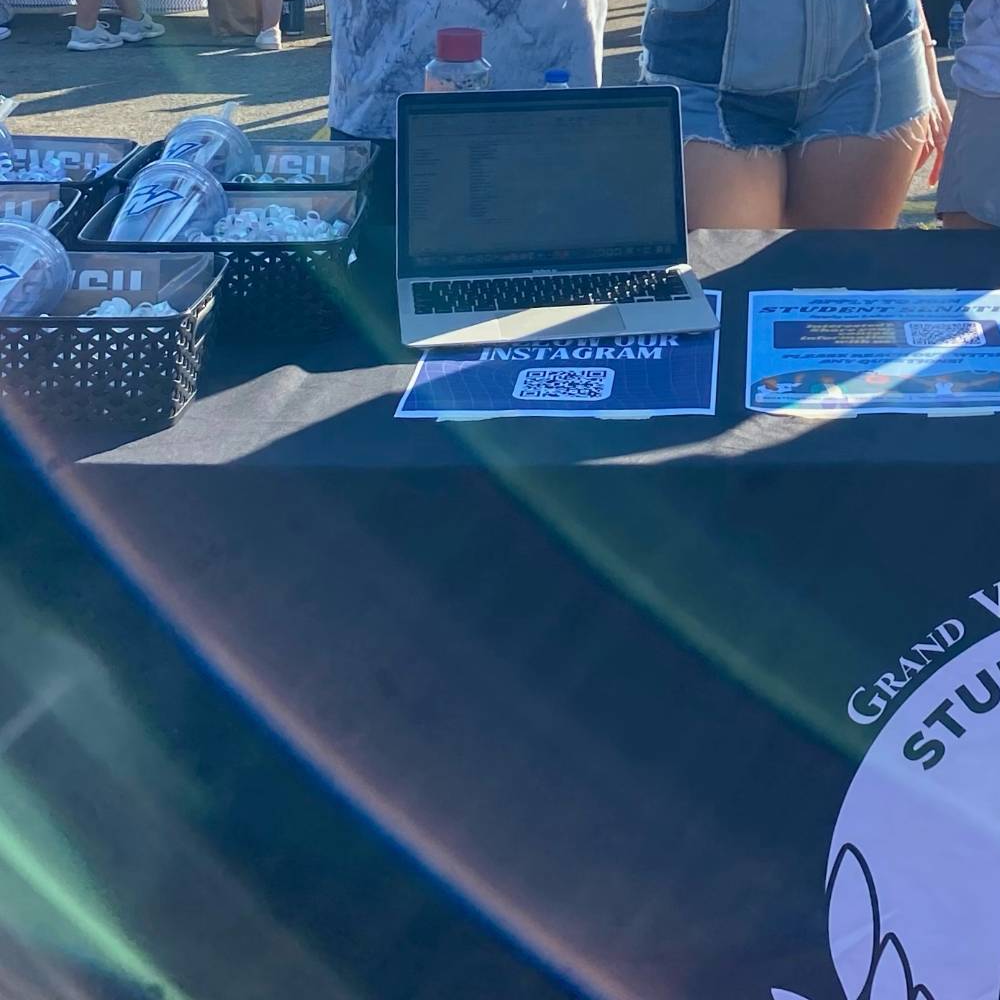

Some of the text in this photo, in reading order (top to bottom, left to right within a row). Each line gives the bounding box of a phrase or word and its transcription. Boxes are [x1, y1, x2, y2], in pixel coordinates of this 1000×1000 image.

[758, 305, 896, 313] STUDENT
[479, 346, 663, 360] INSTAGRAM
[846, 618, 967, 726] GRAND
